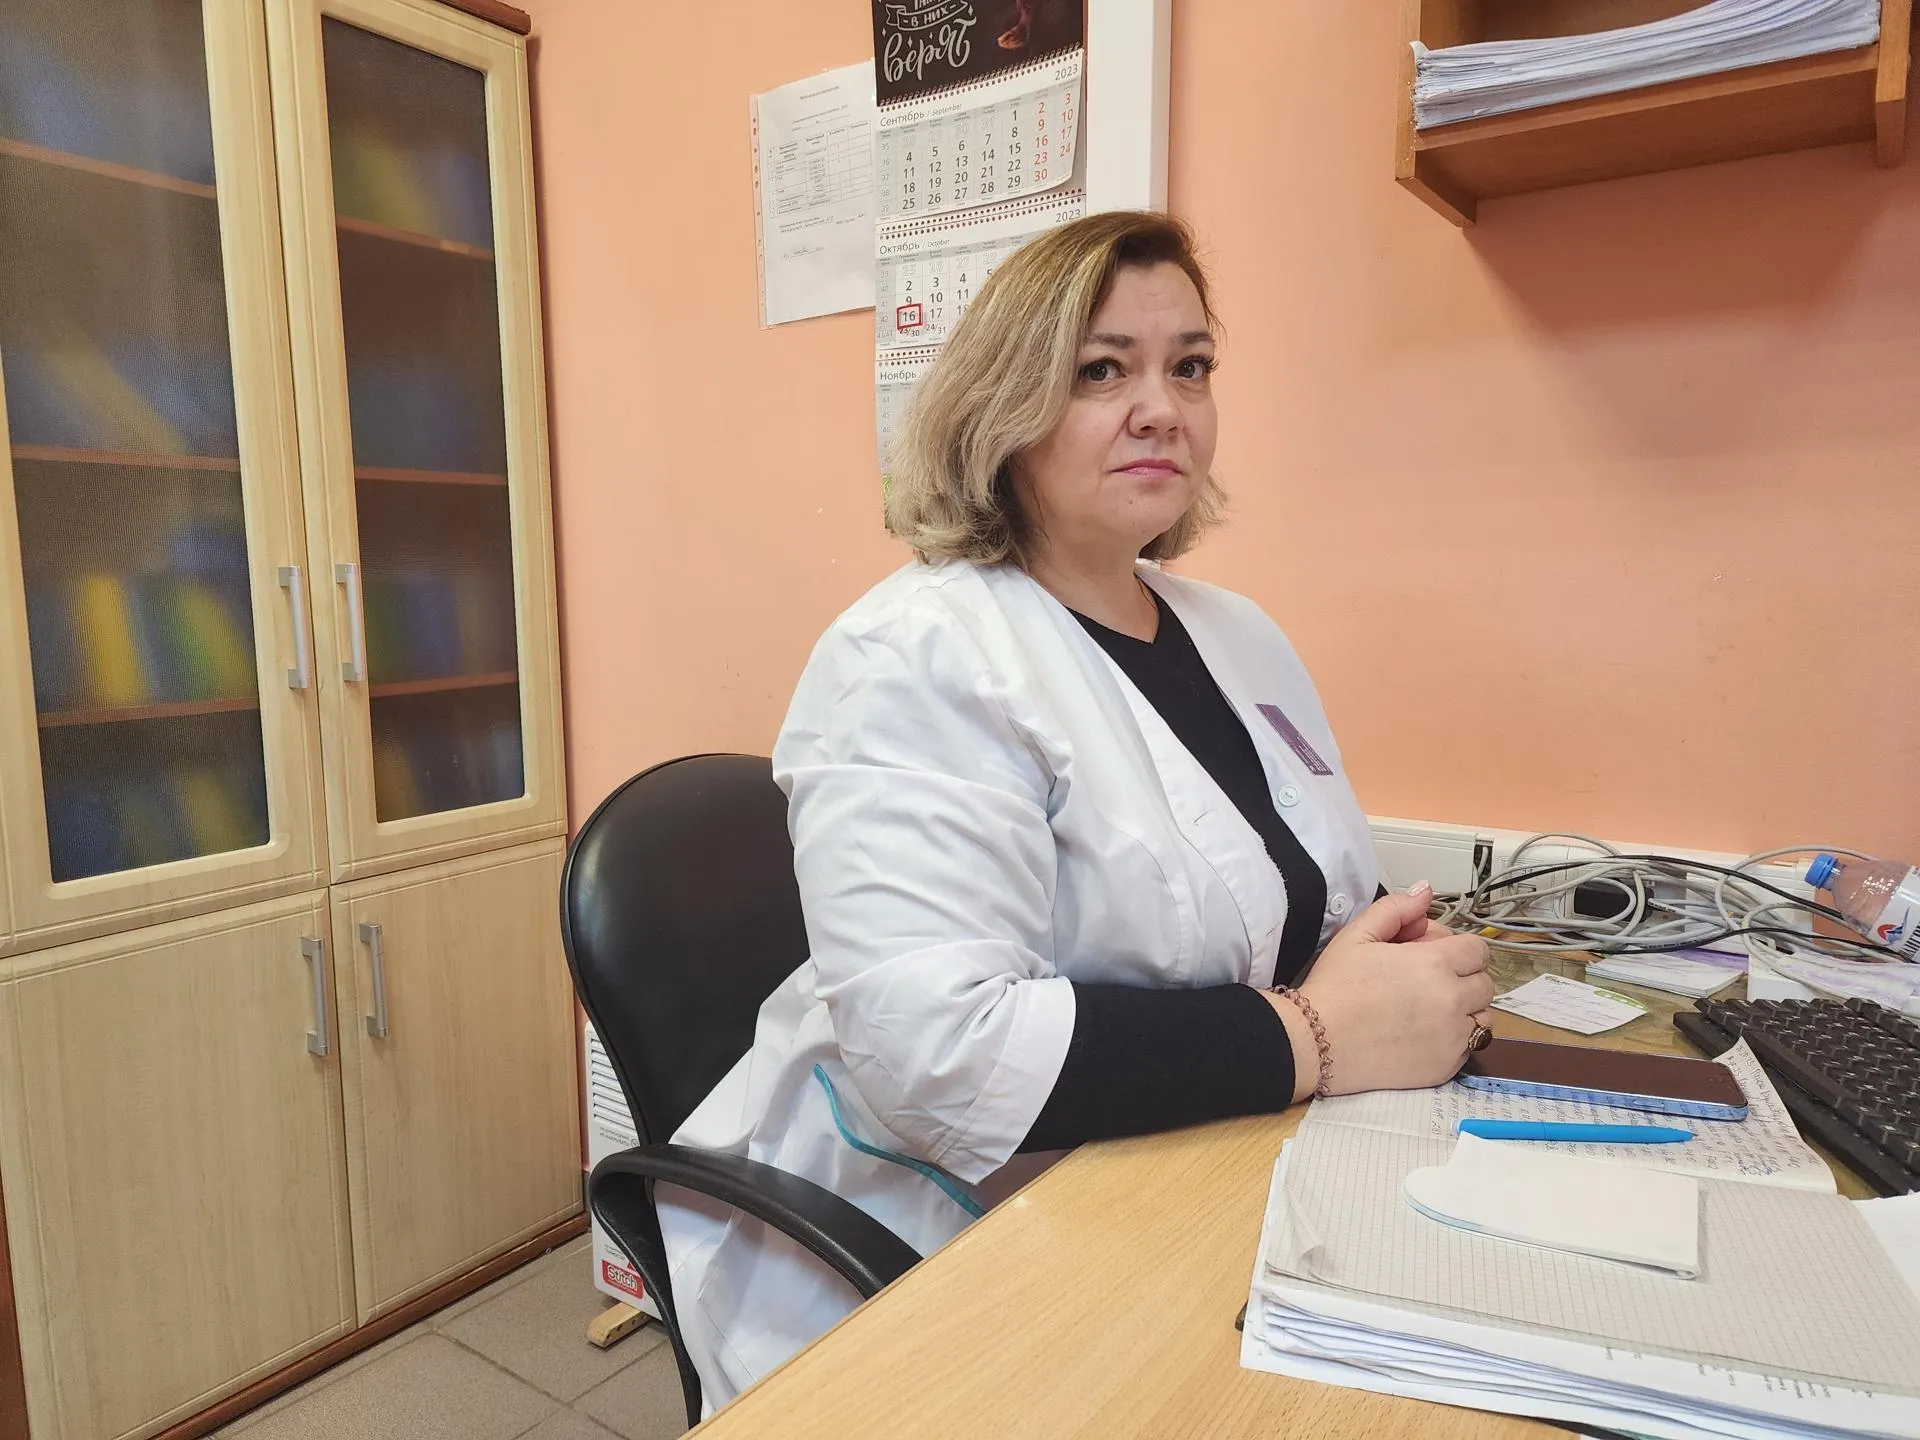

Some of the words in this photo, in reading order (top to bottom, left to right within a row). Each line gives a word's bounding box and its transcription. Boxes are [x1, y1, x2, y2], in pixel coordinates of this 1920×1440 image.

[1054, 64, 1078, 80] 2023
[880, 110, 925, 127] Сентябрь
[932, 104, 962, 116] September
[1012, 110, 1017, 121] 1
[1038, 102, 1045, 114] 2
[1064, 93, 1071, 105] 3
[906, 152, 912, 162] 4
[932, 146, 938, 157] 5
[958, 140, 964, 150] 6
[985, 134, 991, 144] 7
[1012, 126, 1018, 138] 8
[1038, 119, 1045, 131] 9
[1062, 108, 1074, 122] 10
[904, 166, 914, 178] 11
[929, 162, 942, 174] 12
[955, 156, 968, 168] 13
[982, 148, 995, 162] 14
[1008, 142, 1021, 155] 15
[1035, 134, 1048, 148] 16
[1061, 126, 1072, 140] 17
[904, 182, 916, 194] 18
[929, 177, 942, 189] 19
[954, 172, 968, 184] 20
[980, 166, 993, 178] 21
[1008, 158, 1021, 172] 22
[1034, 152, 1048, 165] 23
[1060, 142, 1071, 158] 24
[902, 198, 916, 210] 25
[928, 192, 942, 204] 26
[954, 187, 968, 200] 27
[980, 182, 994, 194] 28
[1008, 175, 1021, 188] 29
[1034, 168, 1048, 182] 30
[1056, 208, 1081, 223] 2023
[880, 241, 920, 255] Октябрь
[927, 239, 950, 248] October
[906, 280, 912, 291] 2
[932, 276, 939, 288] 3
[960, 273, 966, 284] 4
[906, 296, 912, 305] 9
[930, 292, 943, 304] 10
[956, 288, 969, 300] 11
[902, 310, 916, 322] 16
[930, 308, 943, 320] 17
[880, 370, 917, 382] Ноябрь
[608, 1266, 638, 1290] Stitch
